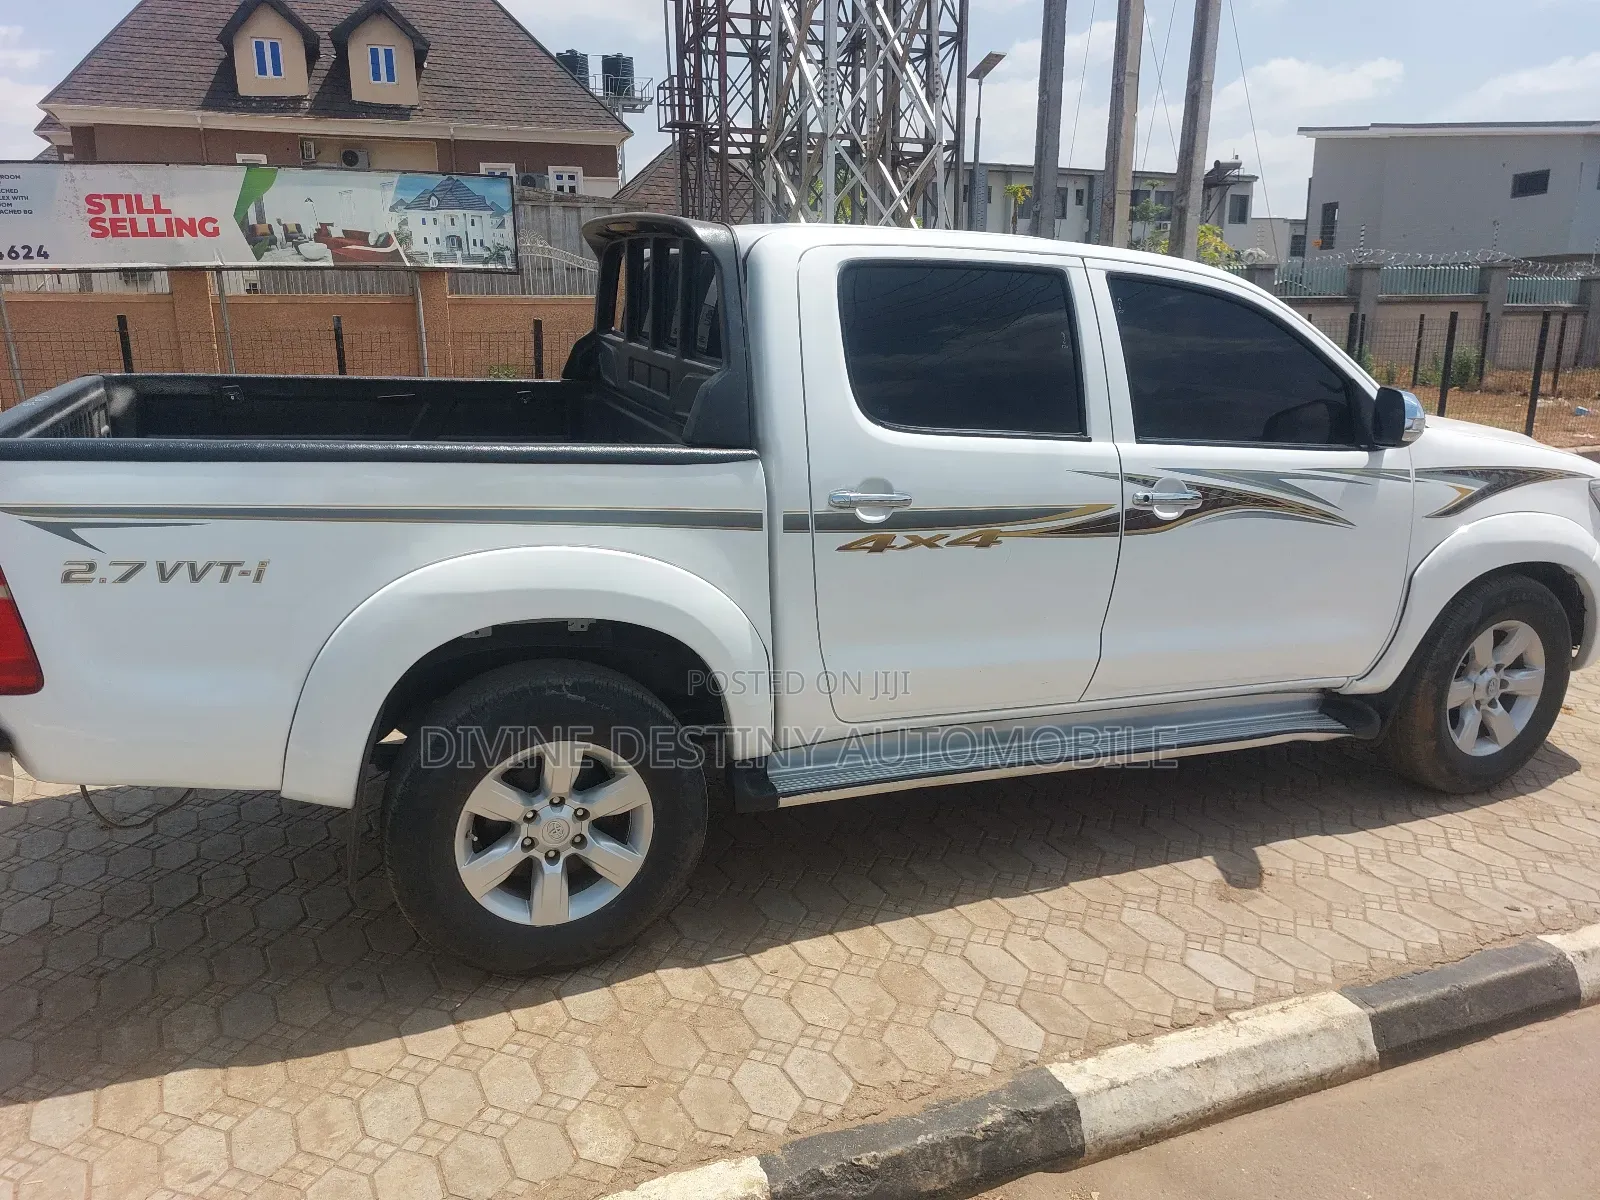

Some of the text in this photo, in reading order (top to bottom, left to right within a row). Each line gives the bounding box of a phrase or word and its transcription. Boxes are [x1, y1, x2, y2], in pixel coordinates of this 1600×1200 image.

[84, 193, 172, 215] STILL
[88, 216, 220, 239] SELLING
[61, 559, 270, 584] 2.7 VVT-i
